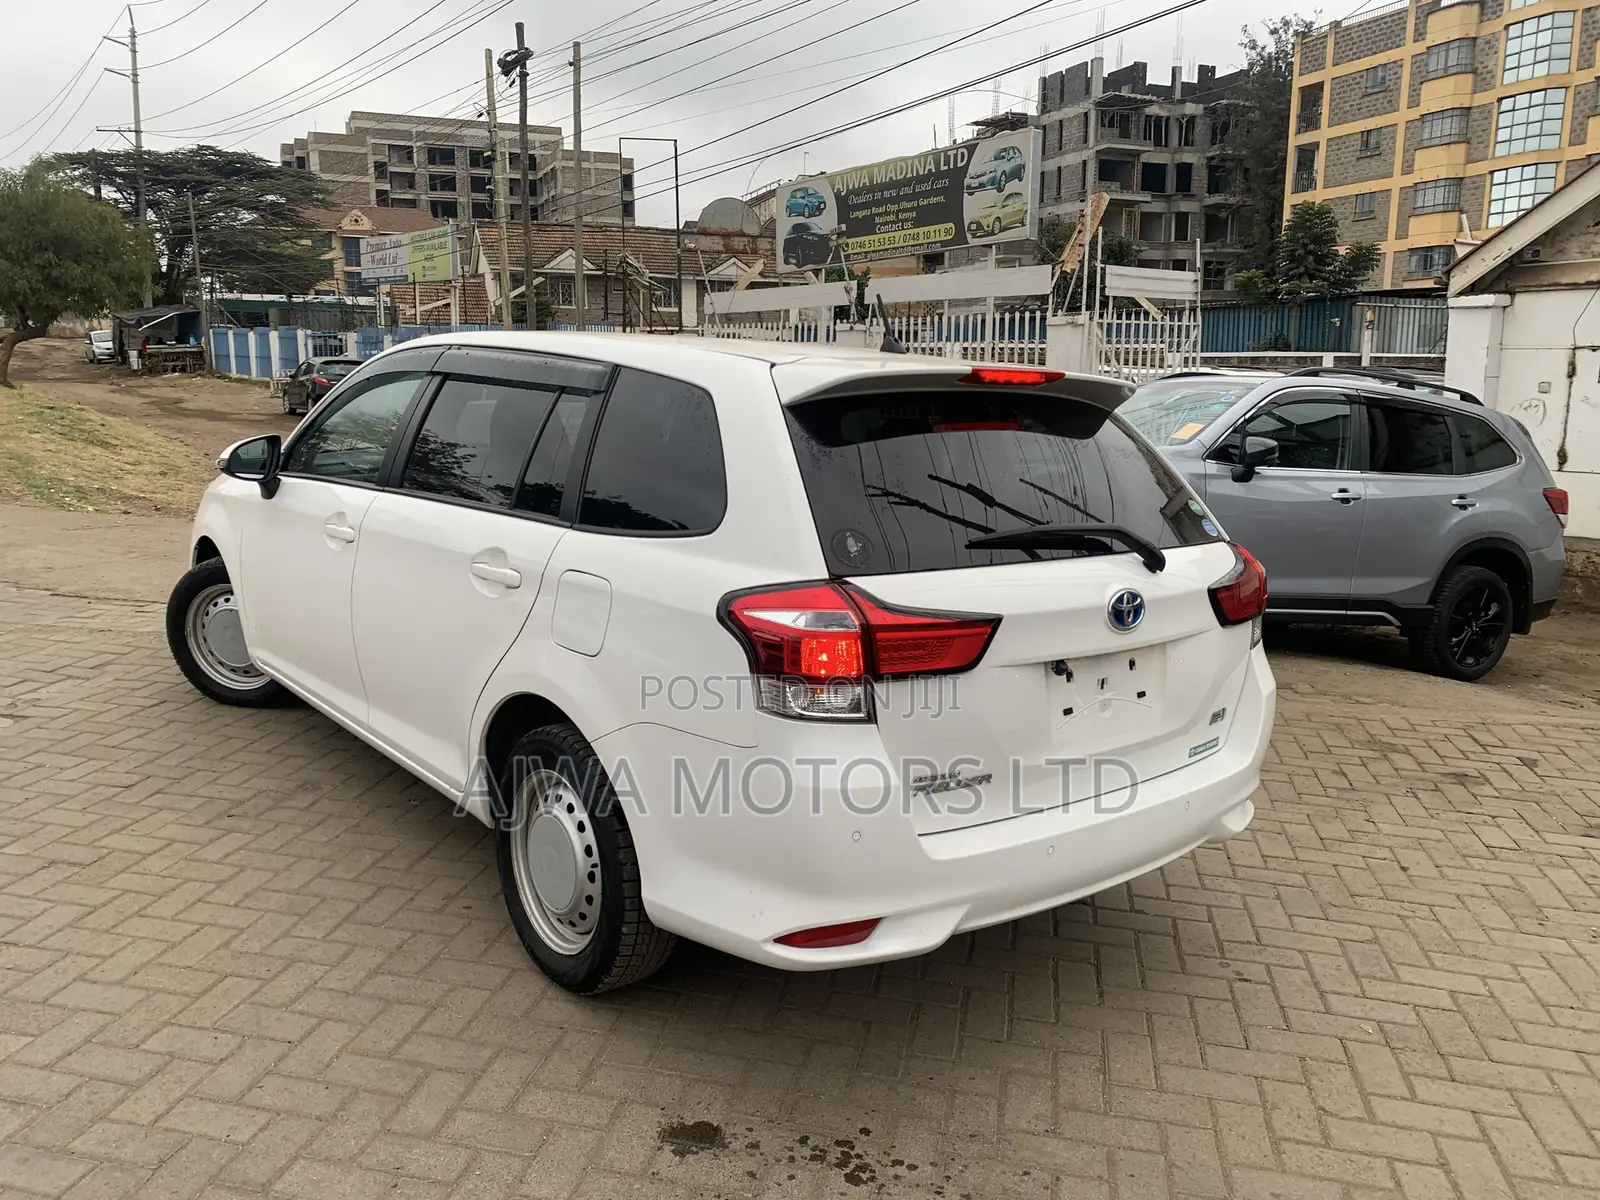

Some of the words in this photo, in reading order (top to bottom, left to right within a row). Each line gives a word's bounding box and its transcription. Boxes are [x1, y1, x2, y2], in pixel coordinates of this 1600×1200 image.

[834, 169, 870, 195] AJWA
[874, 155, 935, 184] MADINA
[940, 147, 969, 171] LTD
[848, 191, 873, 205] Dealers
[874, 187, 882, 200] in
[883, 186, 899, 198] new
[899, 180, 915, 195] and
[915, 177, 932, 193] used
[933, 177, 950, 189] cars
[849, 207, 871, 219] Langata
[871, 204, 886, 215] Road
[918, 194, 946, 206] Gardens,
[875, 213, 898, 224] Nairobi,
[898, 210, 917, 221] Kenya
[876, 221, 902, 233] Contact
[903, 221, 914, 230] us:
[365, 239, 387, 252] Premier
[850, 240, 867, 252] 0746
[867, 238, 876, 249] 51
[878, 237, 886, 247] 53
[887, 235, 896, 246] 53
[902, 230, 920, 244] 0748
[922, 229, 931, 241] 10
[933, 228, 942, 239] 11
[943, 225, 954, 237] 90
[371, 254, 387, 266] World
